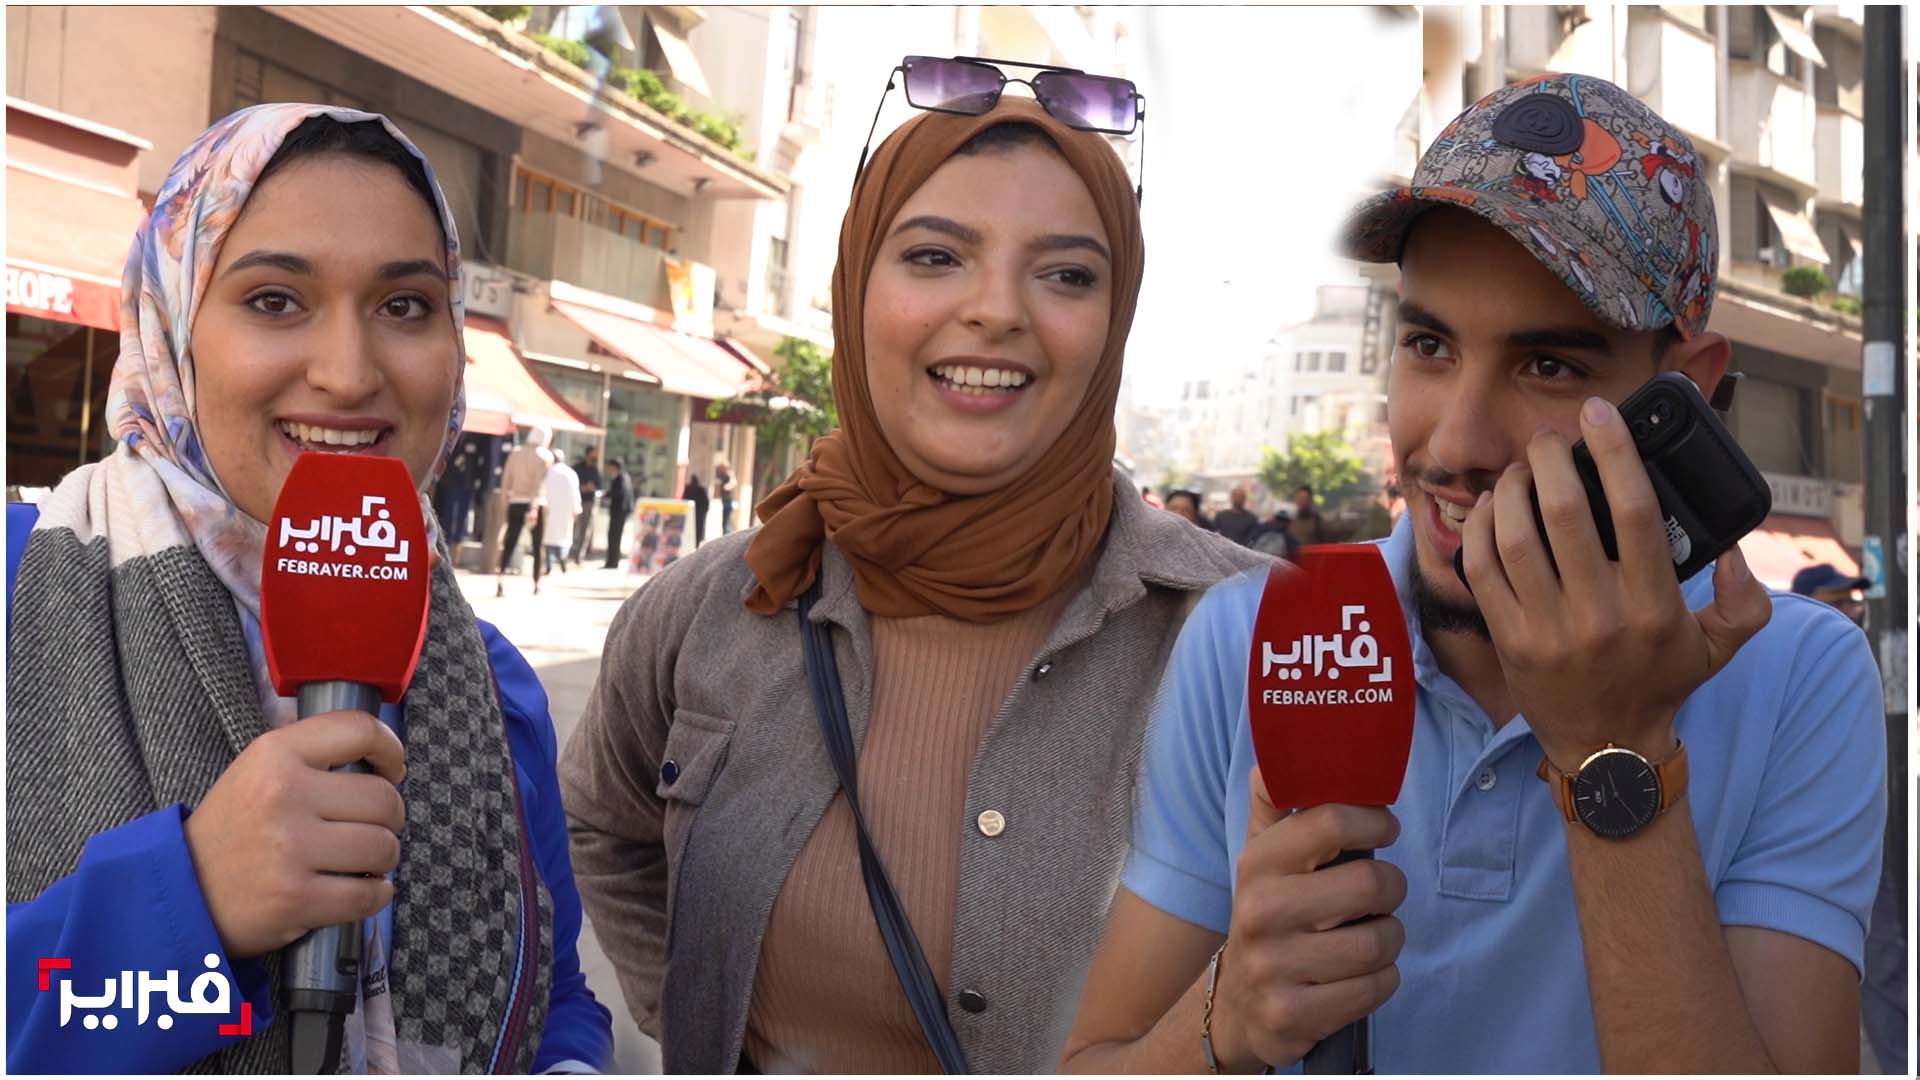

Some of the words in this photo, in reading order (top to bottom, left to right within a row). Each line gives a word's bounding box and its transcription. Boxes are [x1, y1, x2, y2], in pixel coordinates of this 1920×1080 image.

[279, 508, 397, 557] فبراير
[277, 558, 409, 581] FEBRAYER.COM
[1262, 620, 1379, 681] فبراير
[1262, 687, 1393, 705] FEBRAYER.COM
